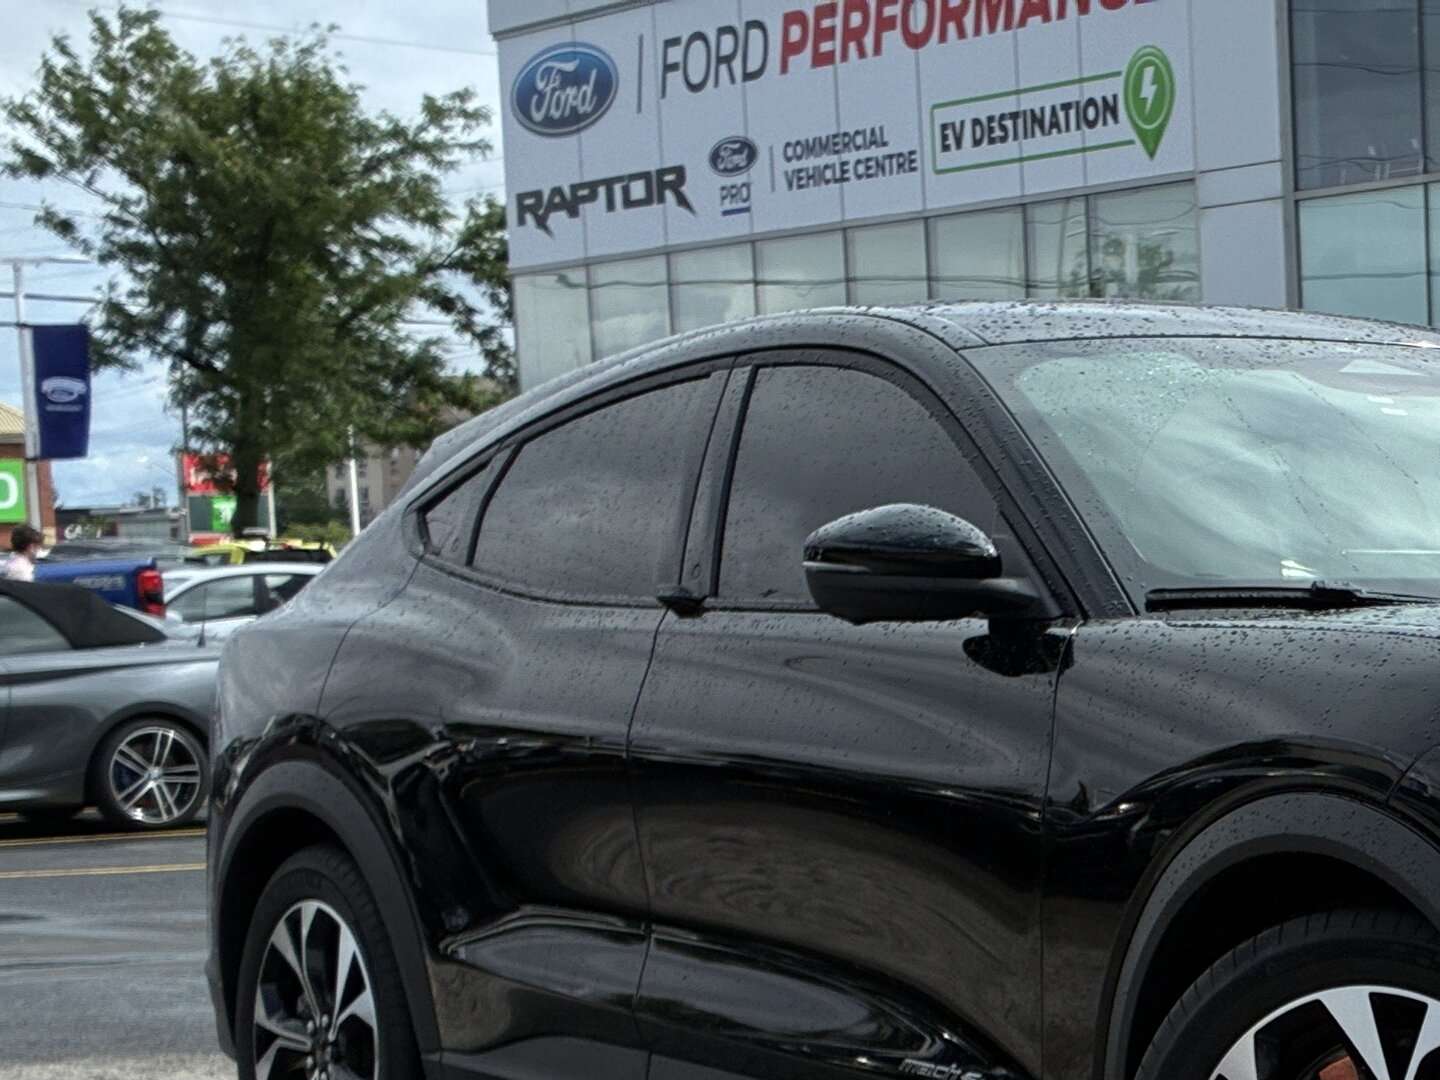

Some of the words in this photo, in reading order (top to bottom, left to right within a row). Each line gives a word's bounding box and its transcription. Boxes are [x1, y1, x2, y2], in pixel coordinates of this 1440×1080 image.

[660, 19, 769, 100] FORD
[529, 57, 600, 124] Ford
[782, 125, 889, 164] COMMERCIAL
[939, 117, 968, 154] EV
[971, 94, 1120, 148] DESTINATION
[716, 142, 750, 171] Ford
[784, 160, 850, 192] VEHICLE
[852, 149, 919, 183] CENTRE
[515, 164, 697, 238] RAPTOR
[719, 182, 752, 207] PRO
